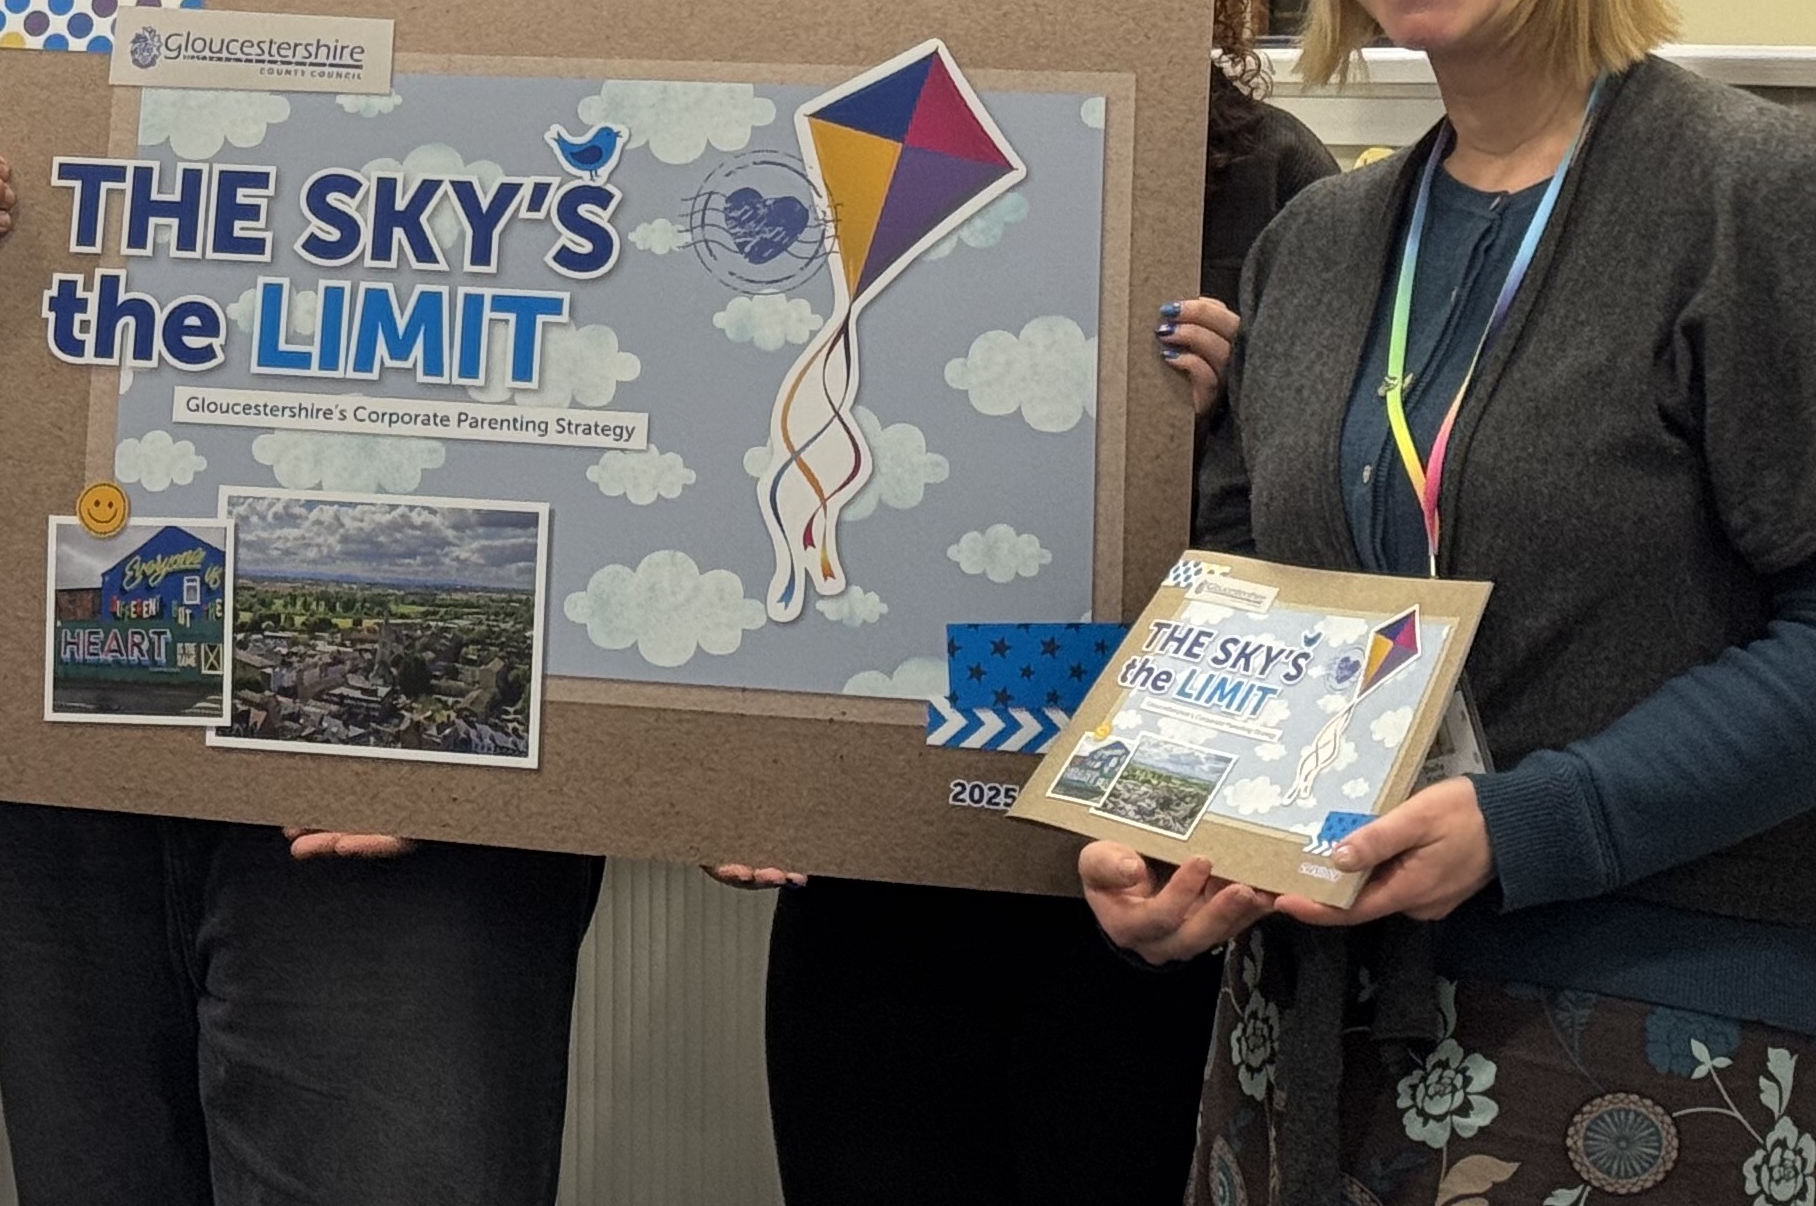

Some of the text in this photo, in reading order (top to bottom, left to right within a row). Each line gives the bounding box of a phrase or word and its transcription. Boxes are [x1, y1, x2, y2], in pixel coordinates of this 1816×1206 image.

[164, 30, 366, 63] Gloucestershire
[259, 67, 363, 81] COUNTY COUNCIL
[56, 161, 620, 276] THE SKY'S
[46, 273, 566, 386] the LIMIT
[185, 396, 637, 442] Gloucestershire's Corporate Parenting Strategy
[60, 628, 173, 666] HEART
[1141, 620, 1314, 683] THE SKY'S
[1118, 656, 1278, 718] the LIMIT
[949, 780, 1019, 809] 2025
